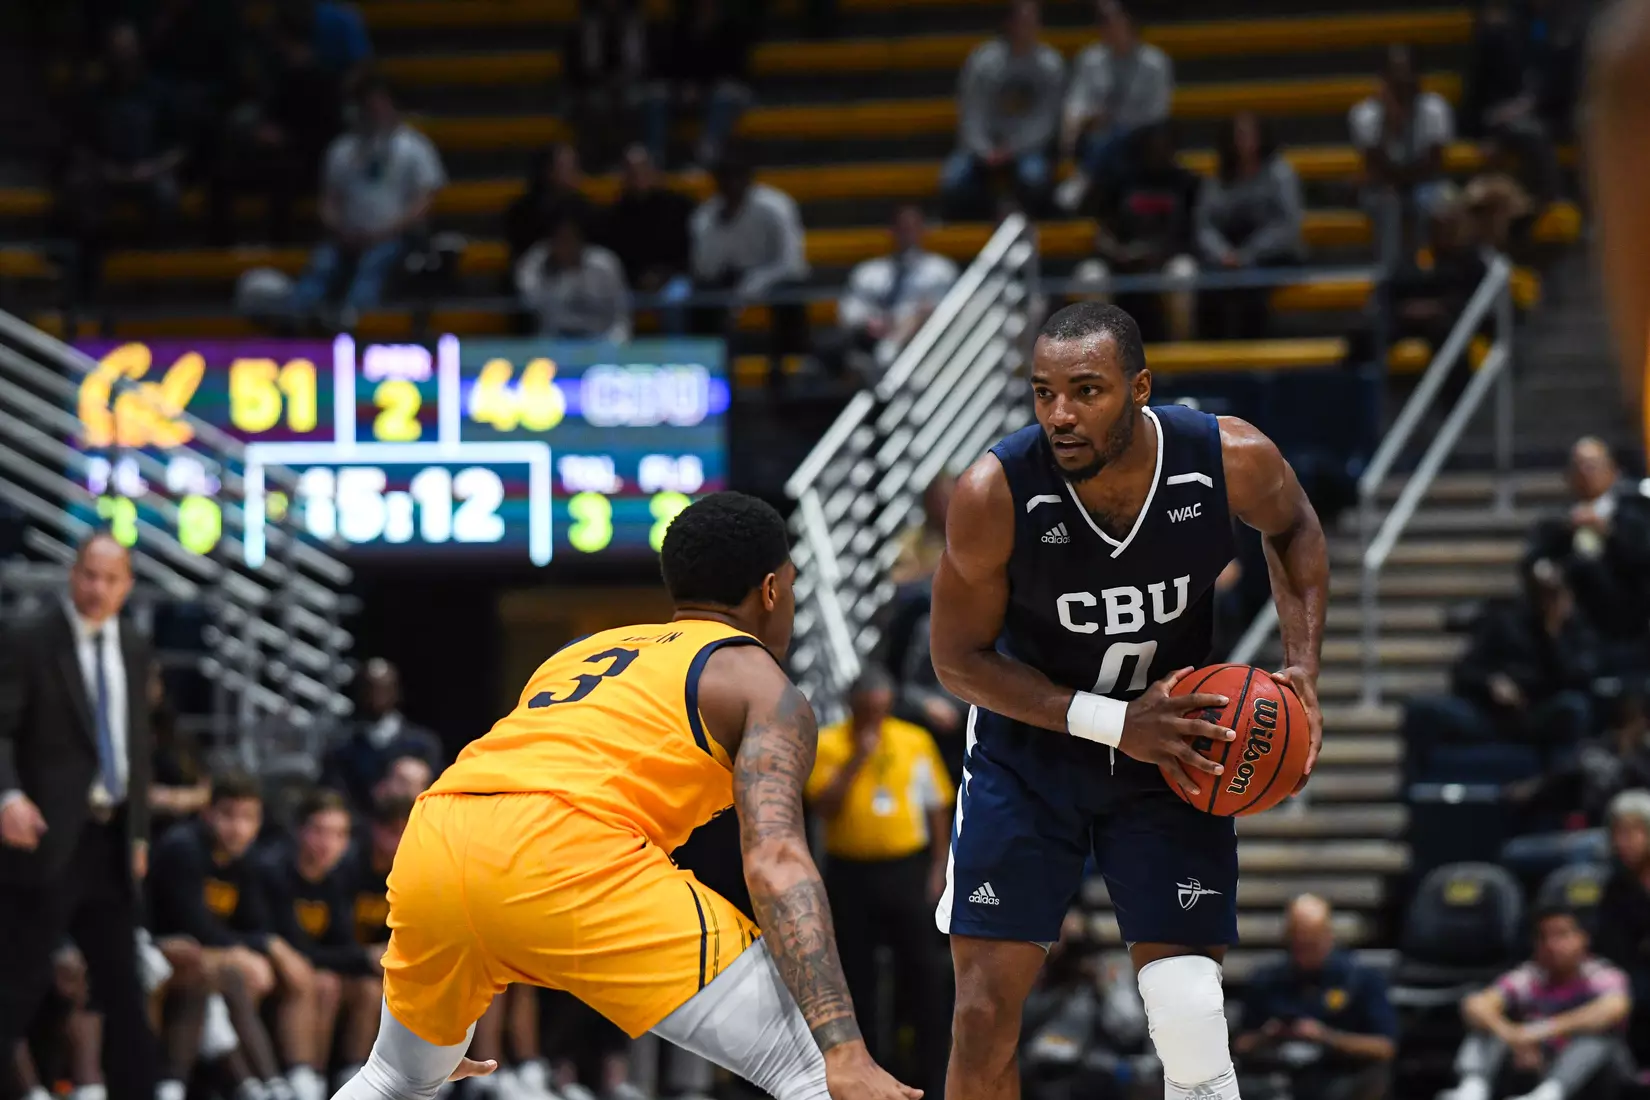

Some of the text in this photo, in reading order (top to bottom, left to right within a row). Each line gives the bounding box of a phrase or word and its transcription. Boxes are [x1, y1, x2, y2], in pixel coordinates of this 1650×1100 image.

[229, 358, 317, 433] 51
[373, 380, 422, 442] 2
[468, 358, 566, 432] 46
[297, 466, 505, 543] 15:12
[568, 491, 613, 553] 3
[1166, 502, 1202, 523] WAC
[1041, 535, 1071, 544] adidas
[1056, 574, 1190, 635] CBU
[528, 647, 639, 709] 3
[1226, 697, 1279, 795] Wilson
[968, 895, 1000, 906] adidas
